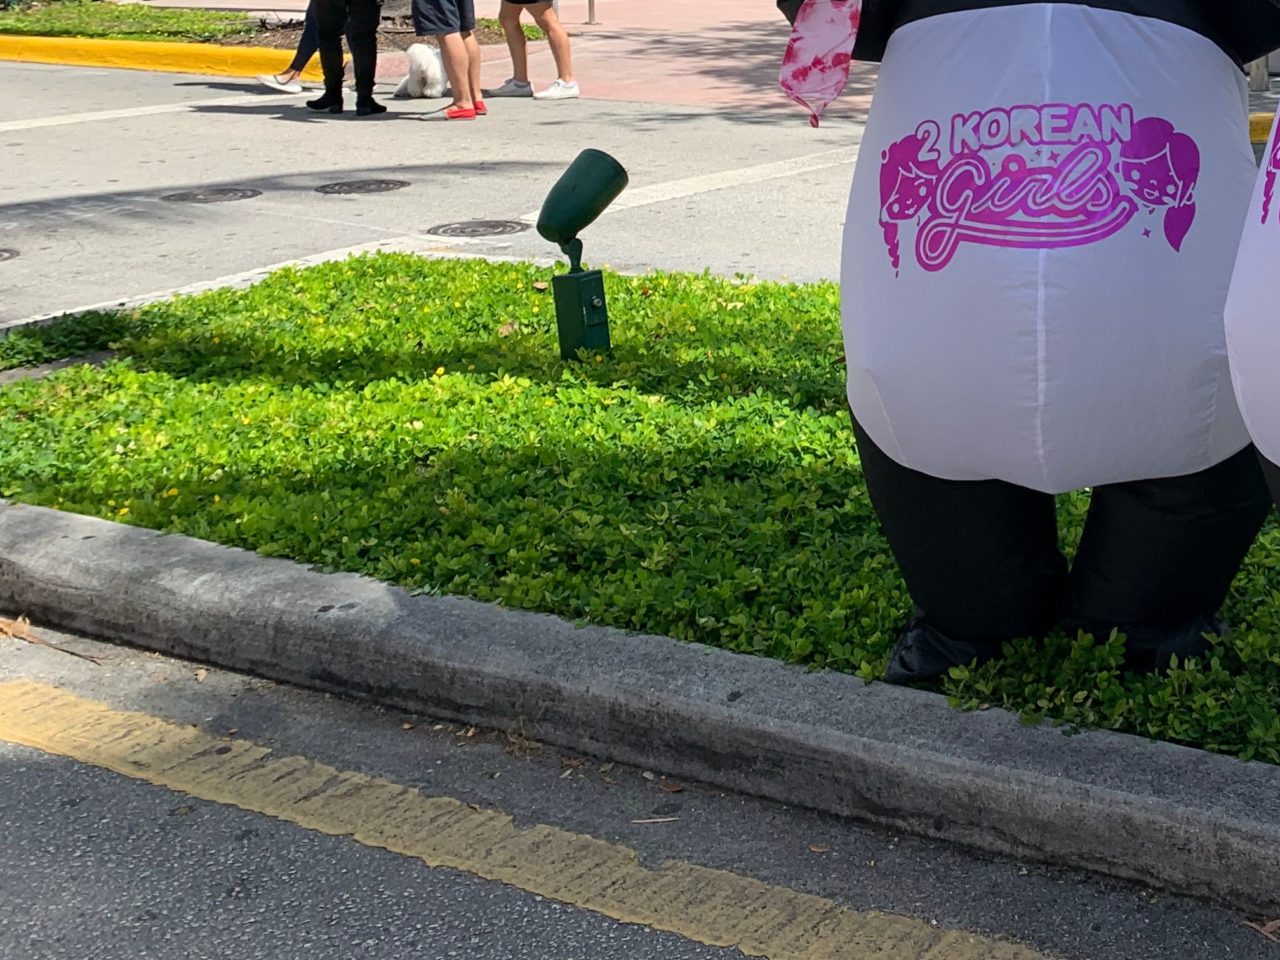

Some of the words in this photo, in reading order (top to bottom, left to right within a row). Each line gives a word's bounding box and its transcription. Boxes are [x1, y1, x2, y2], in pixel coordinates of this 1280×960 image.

[915, 120, 941, 162] 2
[951, 102, 1134, 156] KOREAN
[916, 141, 1138, 272] Girls
